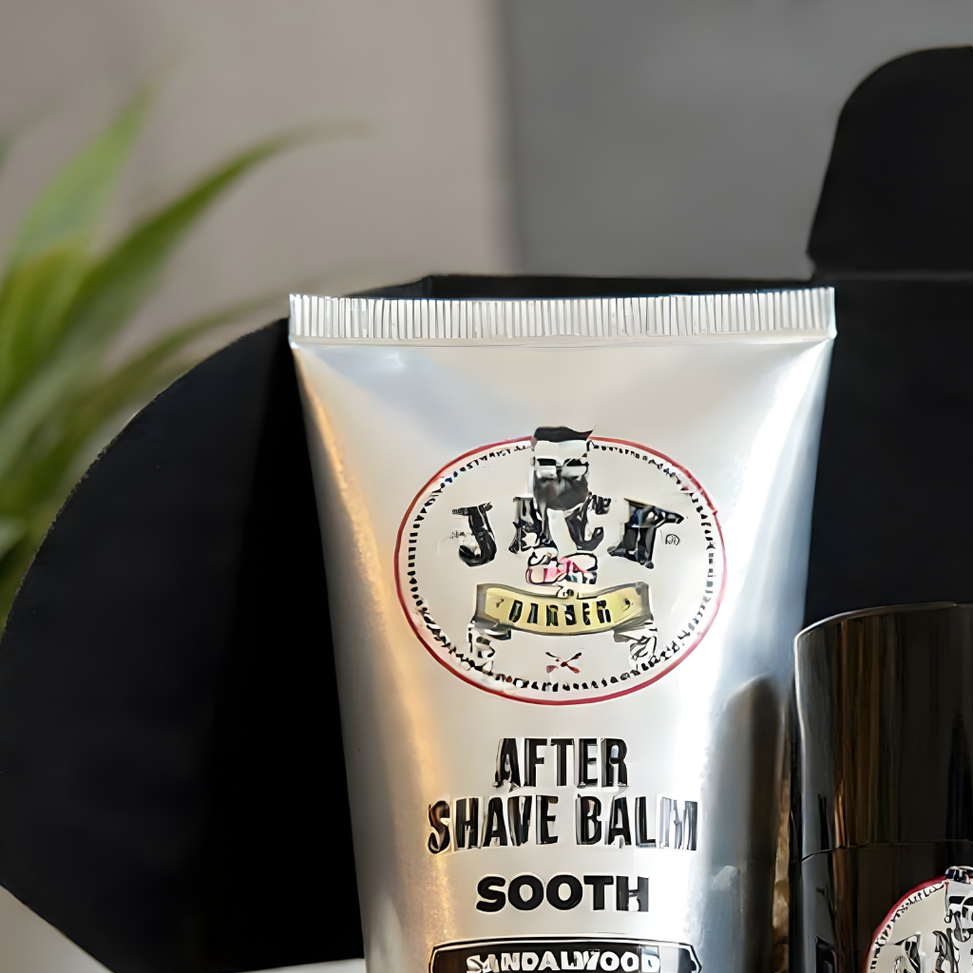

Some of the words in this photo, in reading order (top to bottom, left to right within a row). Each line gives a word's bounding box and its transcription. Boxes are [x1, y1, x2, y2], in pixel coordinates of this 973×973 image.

[492, 737, 629, 788] AFTER
[427, 795, 559, 854] SHAVE
[576, 795, 699, 851] BALM
[475, 873, 650, 913] SOOTH
